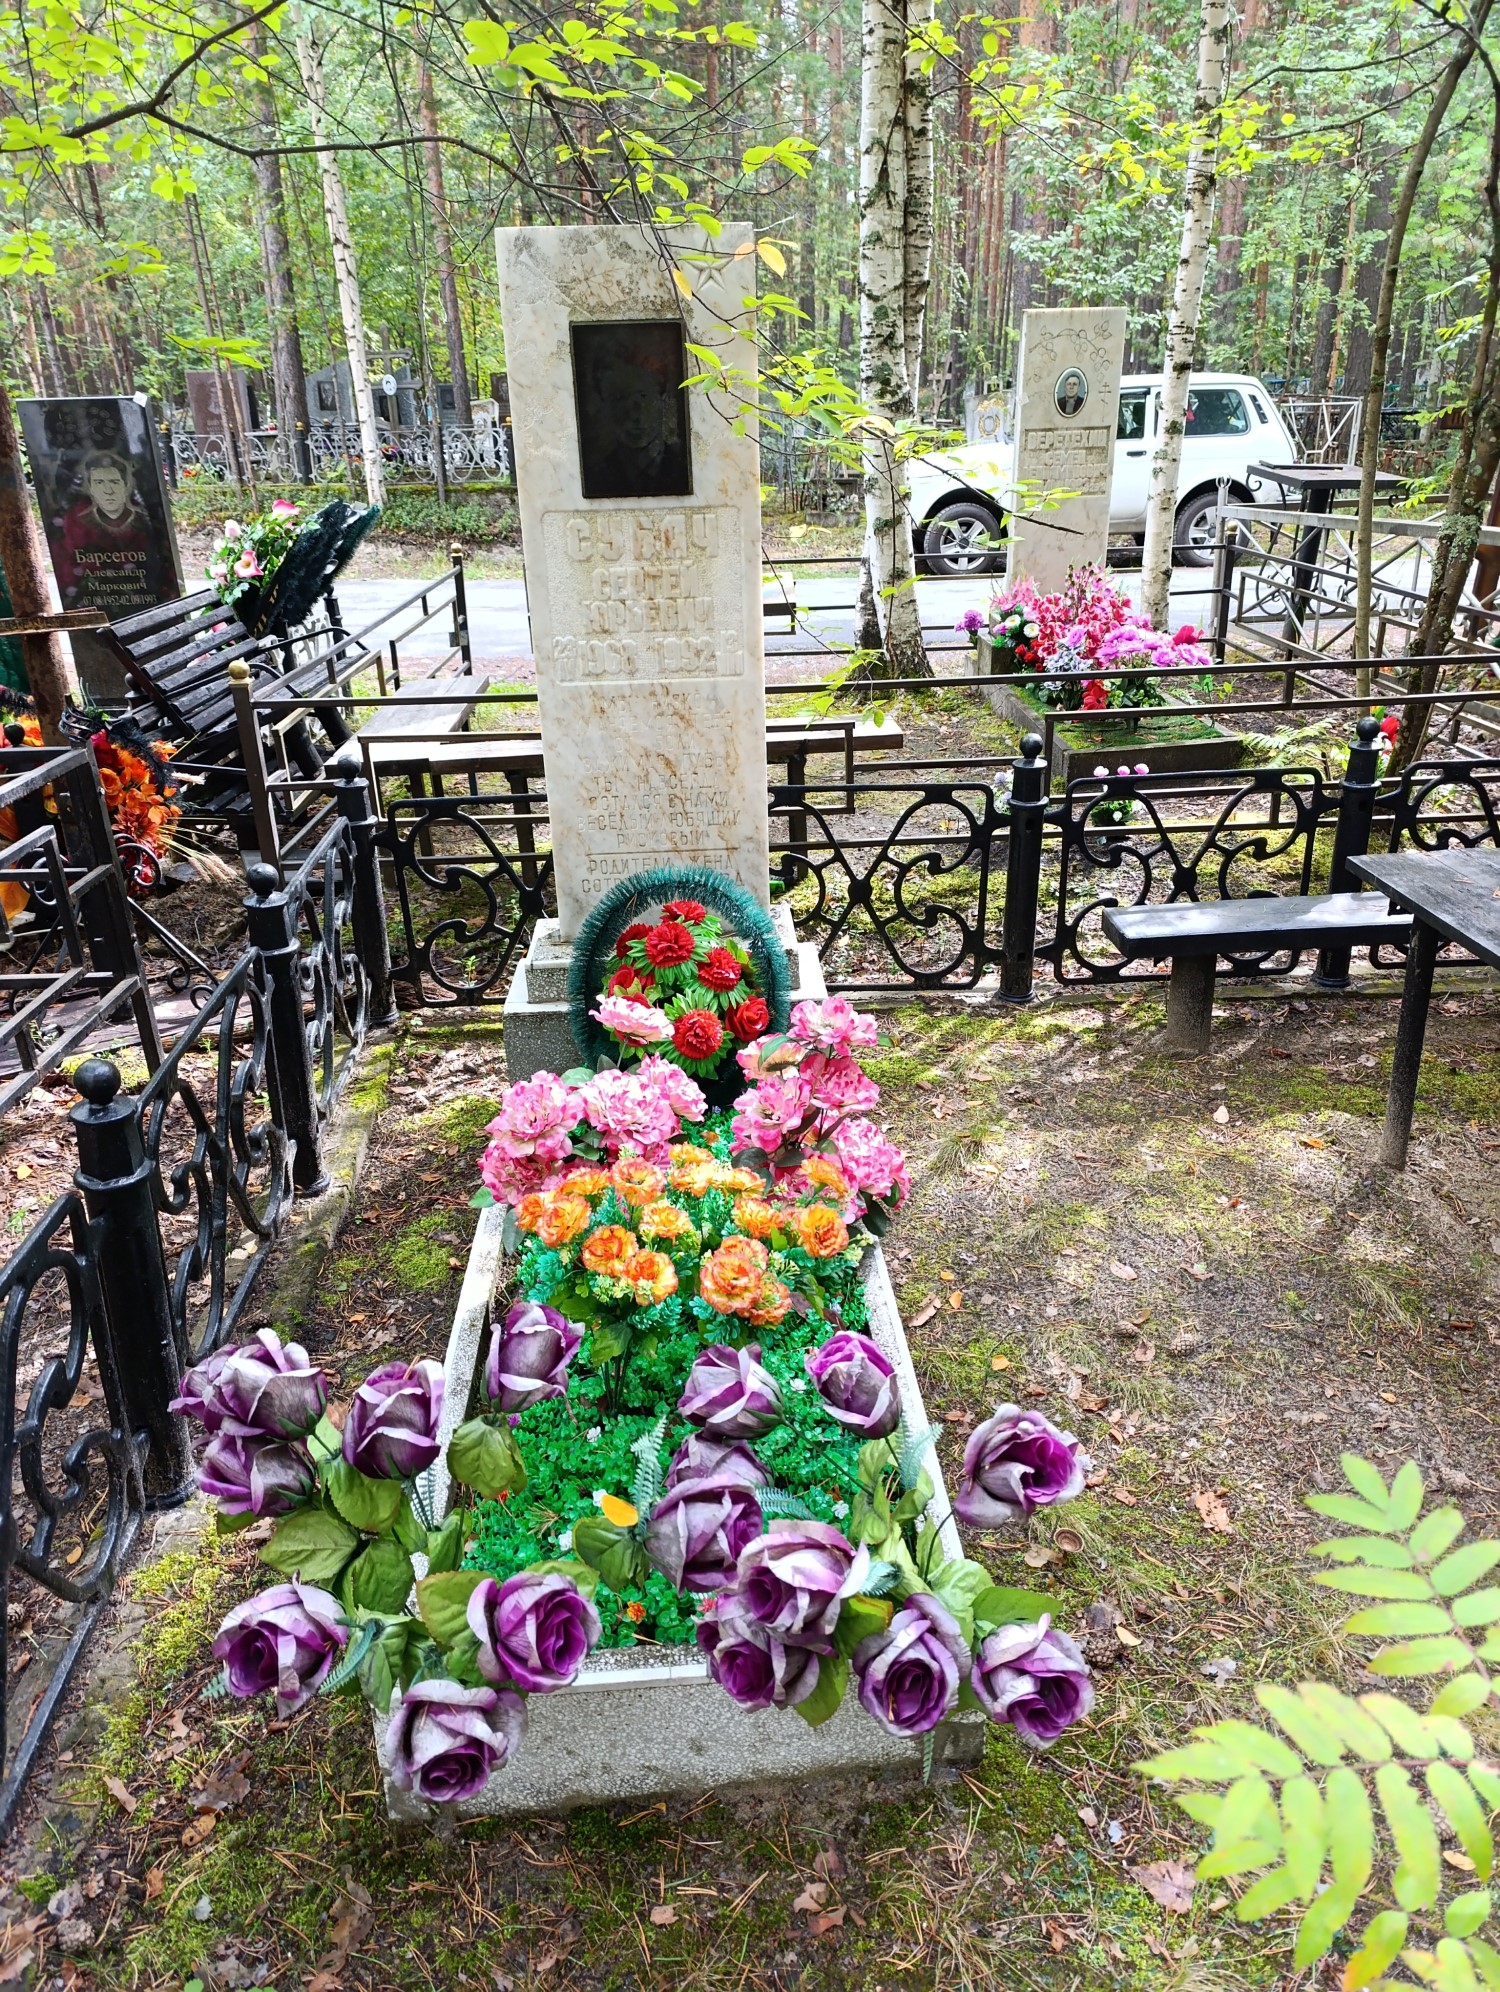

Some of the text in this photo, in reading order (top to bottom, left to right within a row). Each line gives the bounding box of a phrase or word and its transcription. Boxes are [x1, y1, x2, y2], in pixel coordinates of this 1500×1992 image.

[567, 514, 718, 561] СУБАЧ
[74, 549, 147, 567] Барсегов
[84, 568, 147, 578] Александр
[592, 559, 698, 600] СЕРГЕЙ
[87, 581, 147, 593] Маркович
[582, 597, 714, 634] ЮРЬЕВИЧ
[577, 638, 637, 676] 1968
[655, 635, 716, 673] 1992
[594, 775, 619, 793] ТЫ
[589, 794, 661, 811] ОСТАЛСЯ
[683, 790, 729, 808] НАМИ
